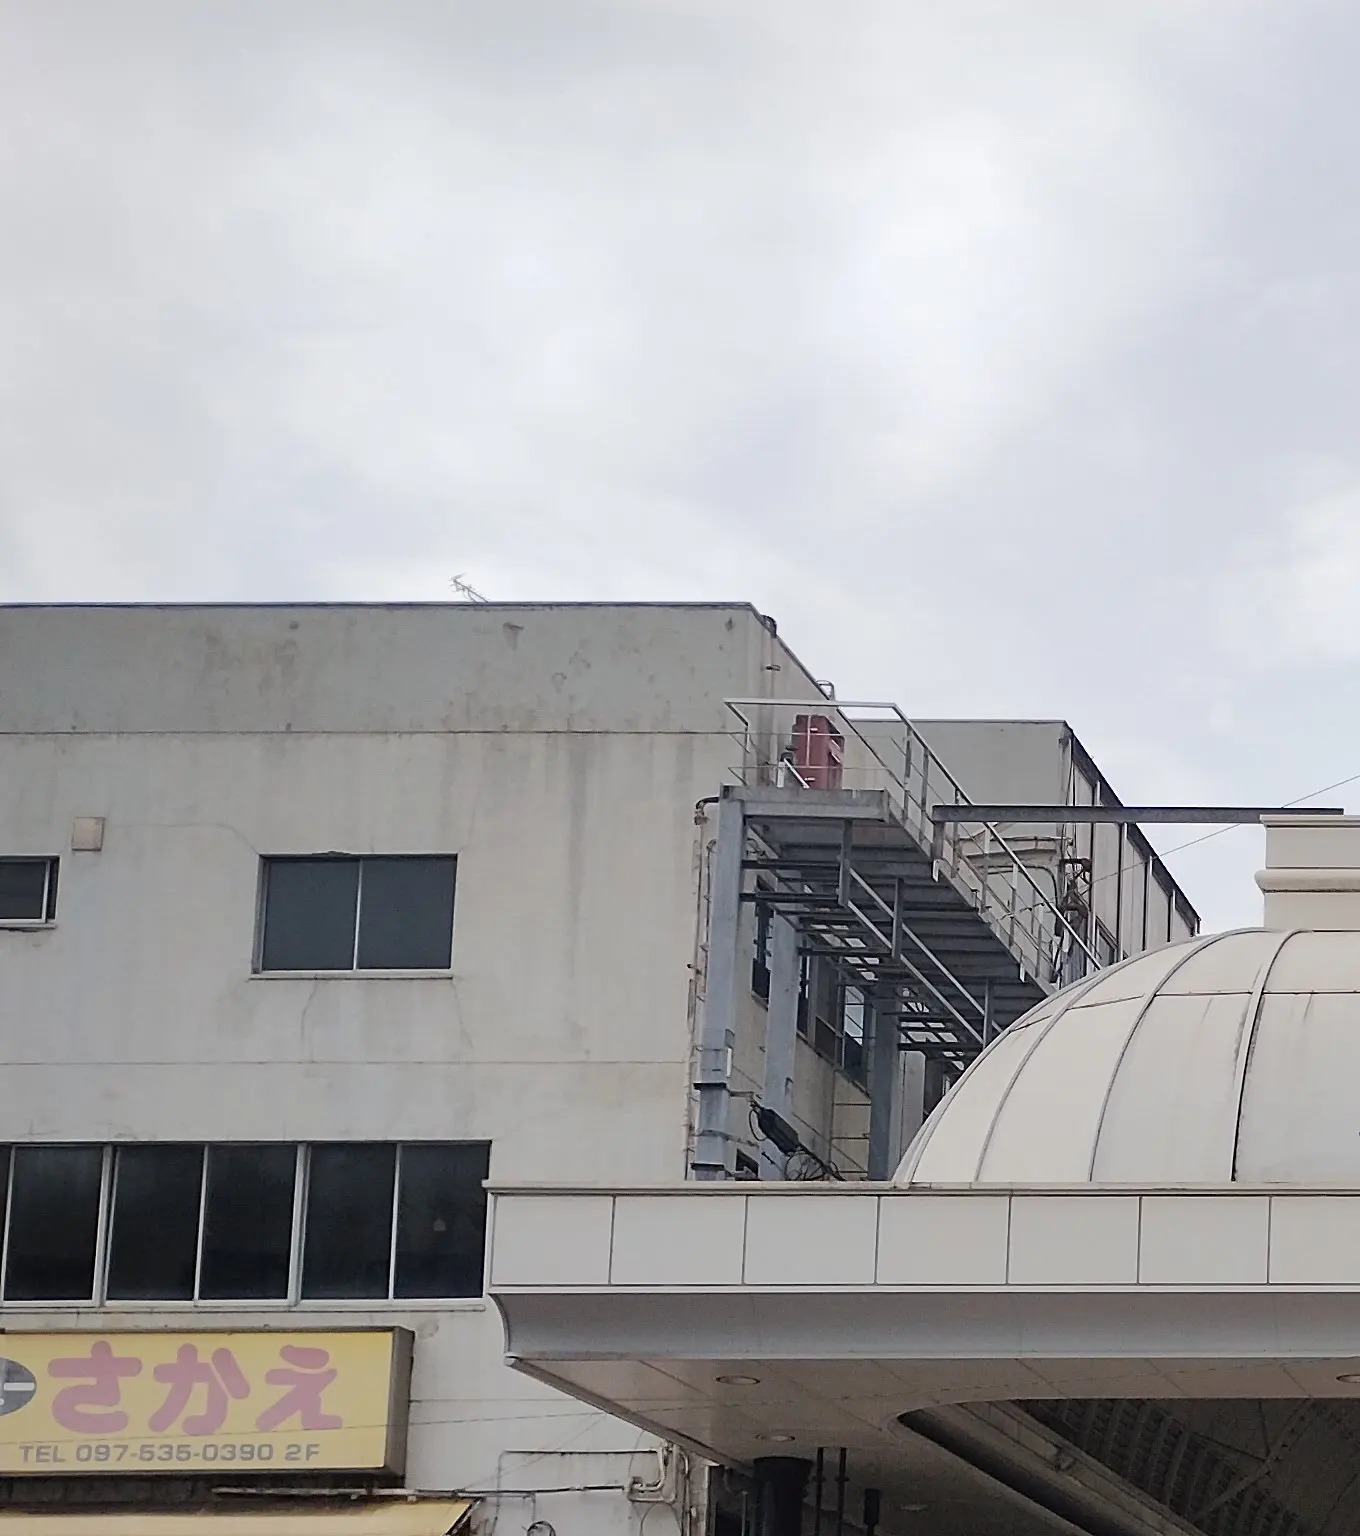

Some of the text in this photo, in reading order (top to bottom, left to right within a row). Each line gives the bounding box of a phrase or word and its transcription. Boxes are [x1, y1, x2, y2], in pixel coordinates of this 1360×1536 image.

[47, 1341, 343, 1436] さかえ
[19, 1443, 320, 1464] TEL 097-535-0390 2F
